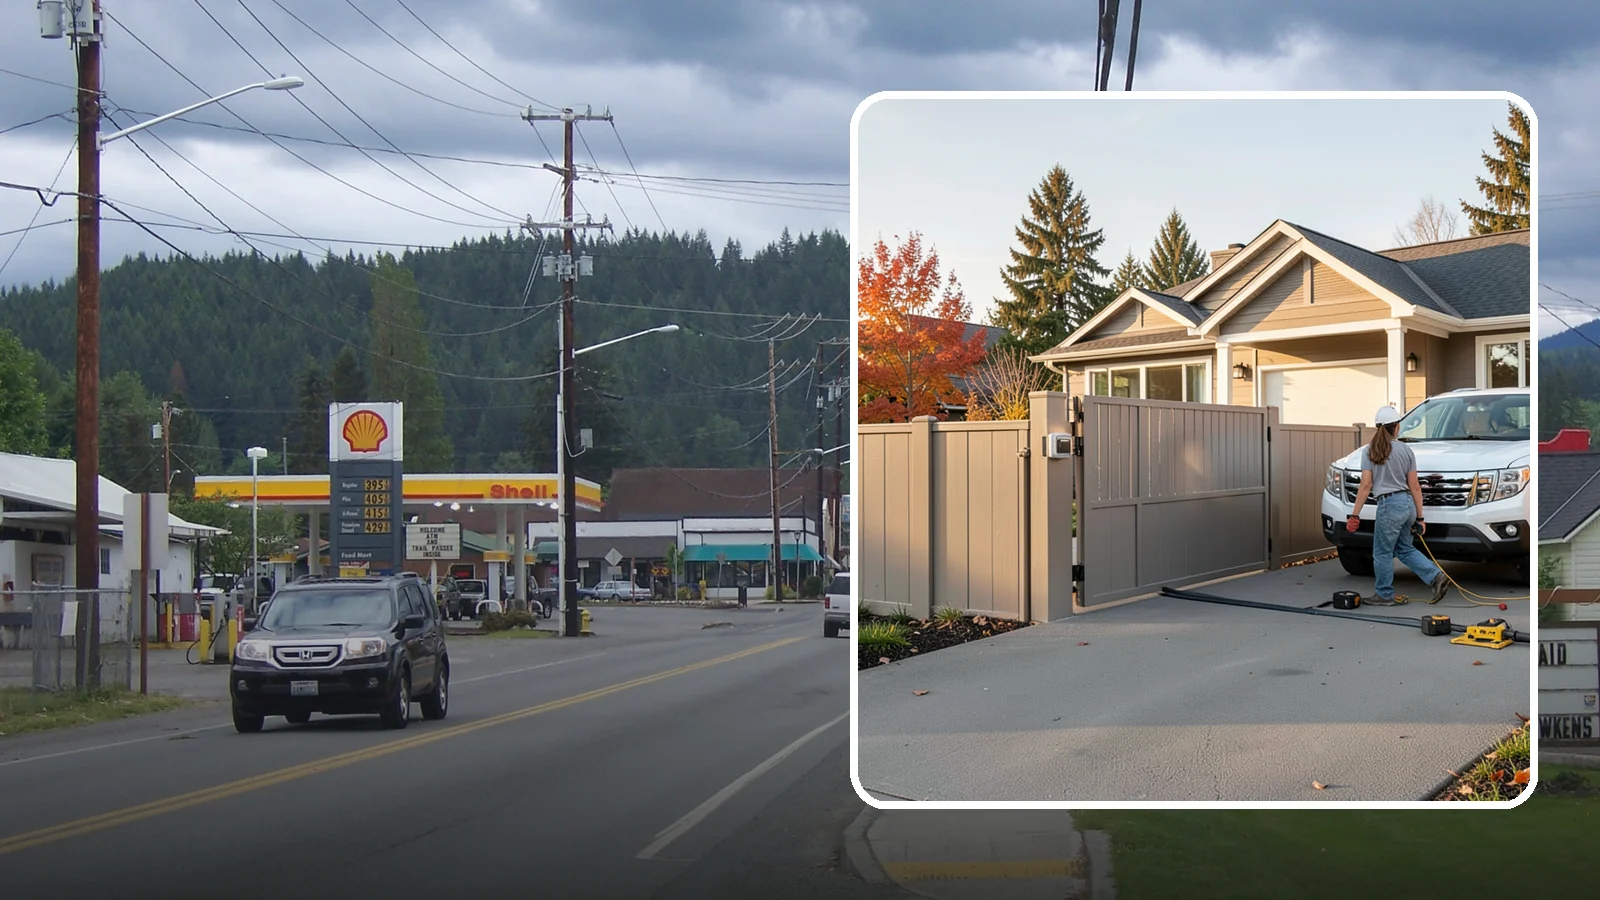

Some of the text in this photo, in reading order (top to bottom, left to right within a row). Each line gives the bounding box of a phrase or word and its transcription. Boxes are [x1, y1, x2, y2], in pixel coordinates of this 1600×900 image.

[490, 484, 547, 498] Shell
[366, 522, 383, 532] 429
[1538, 642, 1566, 666] AID
